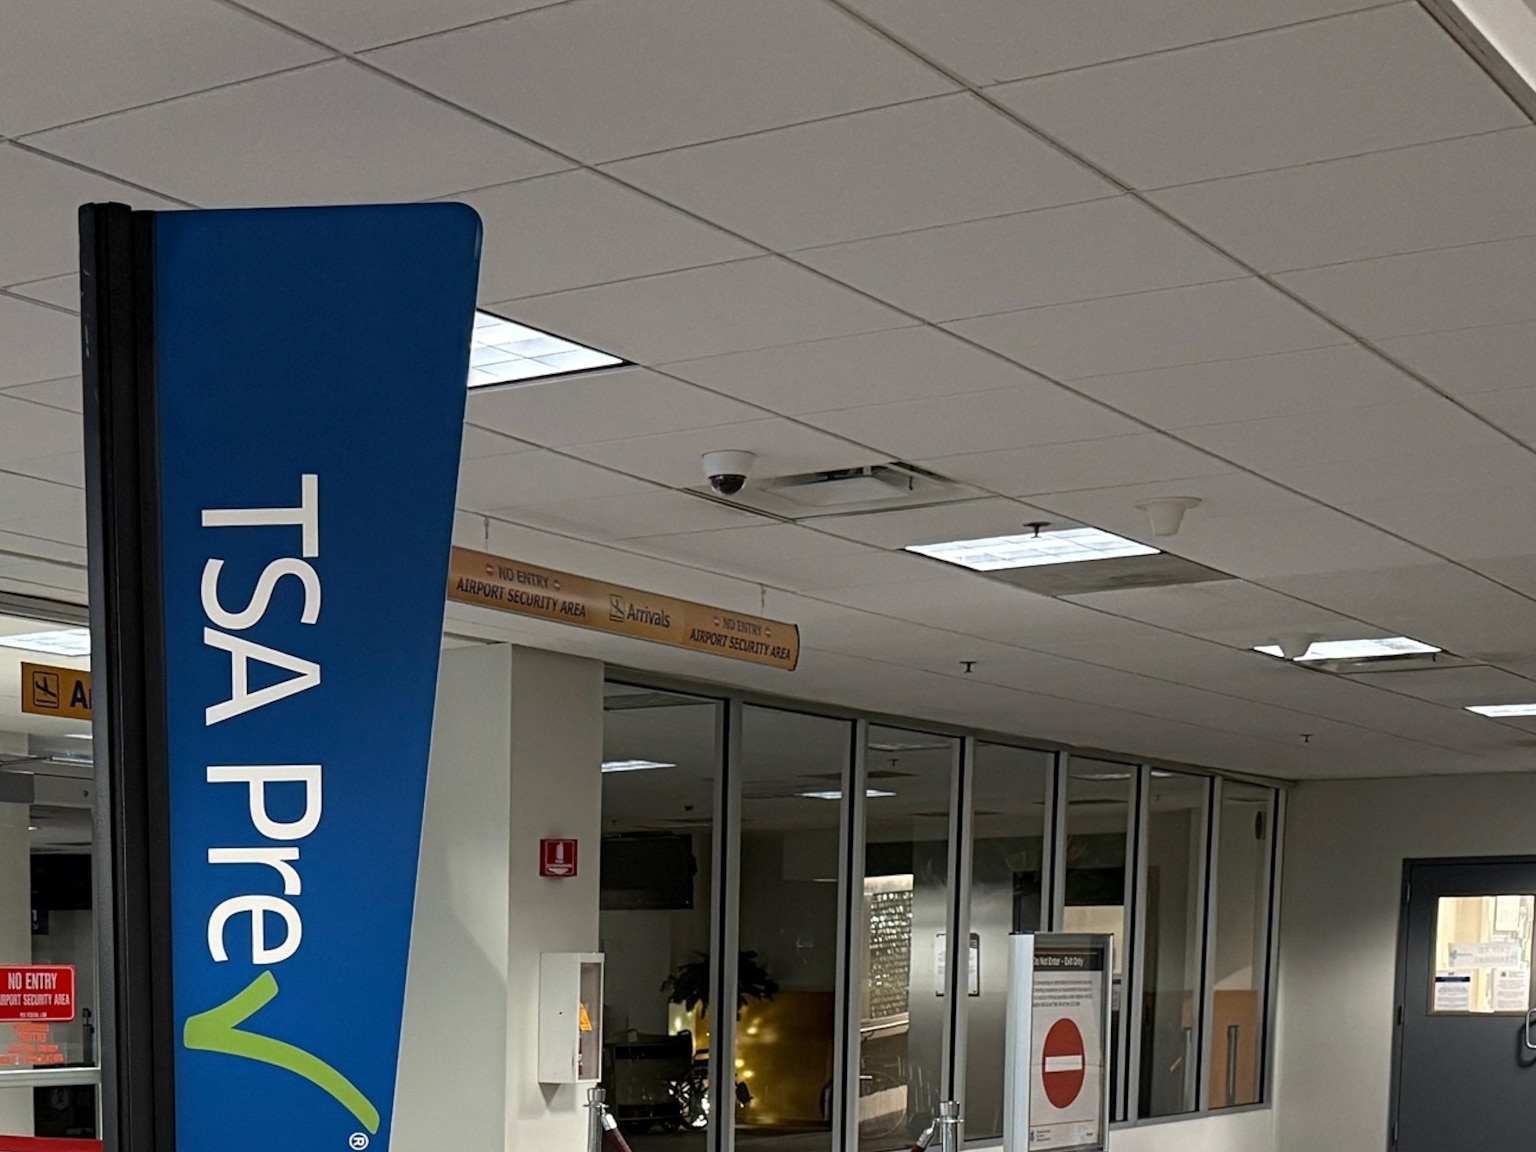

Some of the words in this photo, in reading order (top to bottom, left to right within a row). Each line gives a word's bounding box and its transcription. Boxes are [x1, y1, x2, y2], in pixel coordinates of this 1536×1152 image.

[497, 565, 515, 582] NO
[517, 569, 550, 590] ENTRY
[201, 474, 322, 727] TSA
[456, 577, 505, 601] AIRPORT
[507, 587, 560, 612] SECURITY
[560, 599, 586, 618] AREA
[627, 602, 671, 629] Arrivals
[723, 618, 735, 631] NO
[737, 621, 762, 637] ENTRY
[689, 628, 728, 649] AIRPORT
[728, 636, 770, 657] SECURITY
[769, 645, 791, 661] AREA
[7, 972, 22, 990] NO
[25, 972, 58, 990] ENTRY
[22, 993, 53, 1007] SECURITY
[53, 993, 71, 1006] AREA
